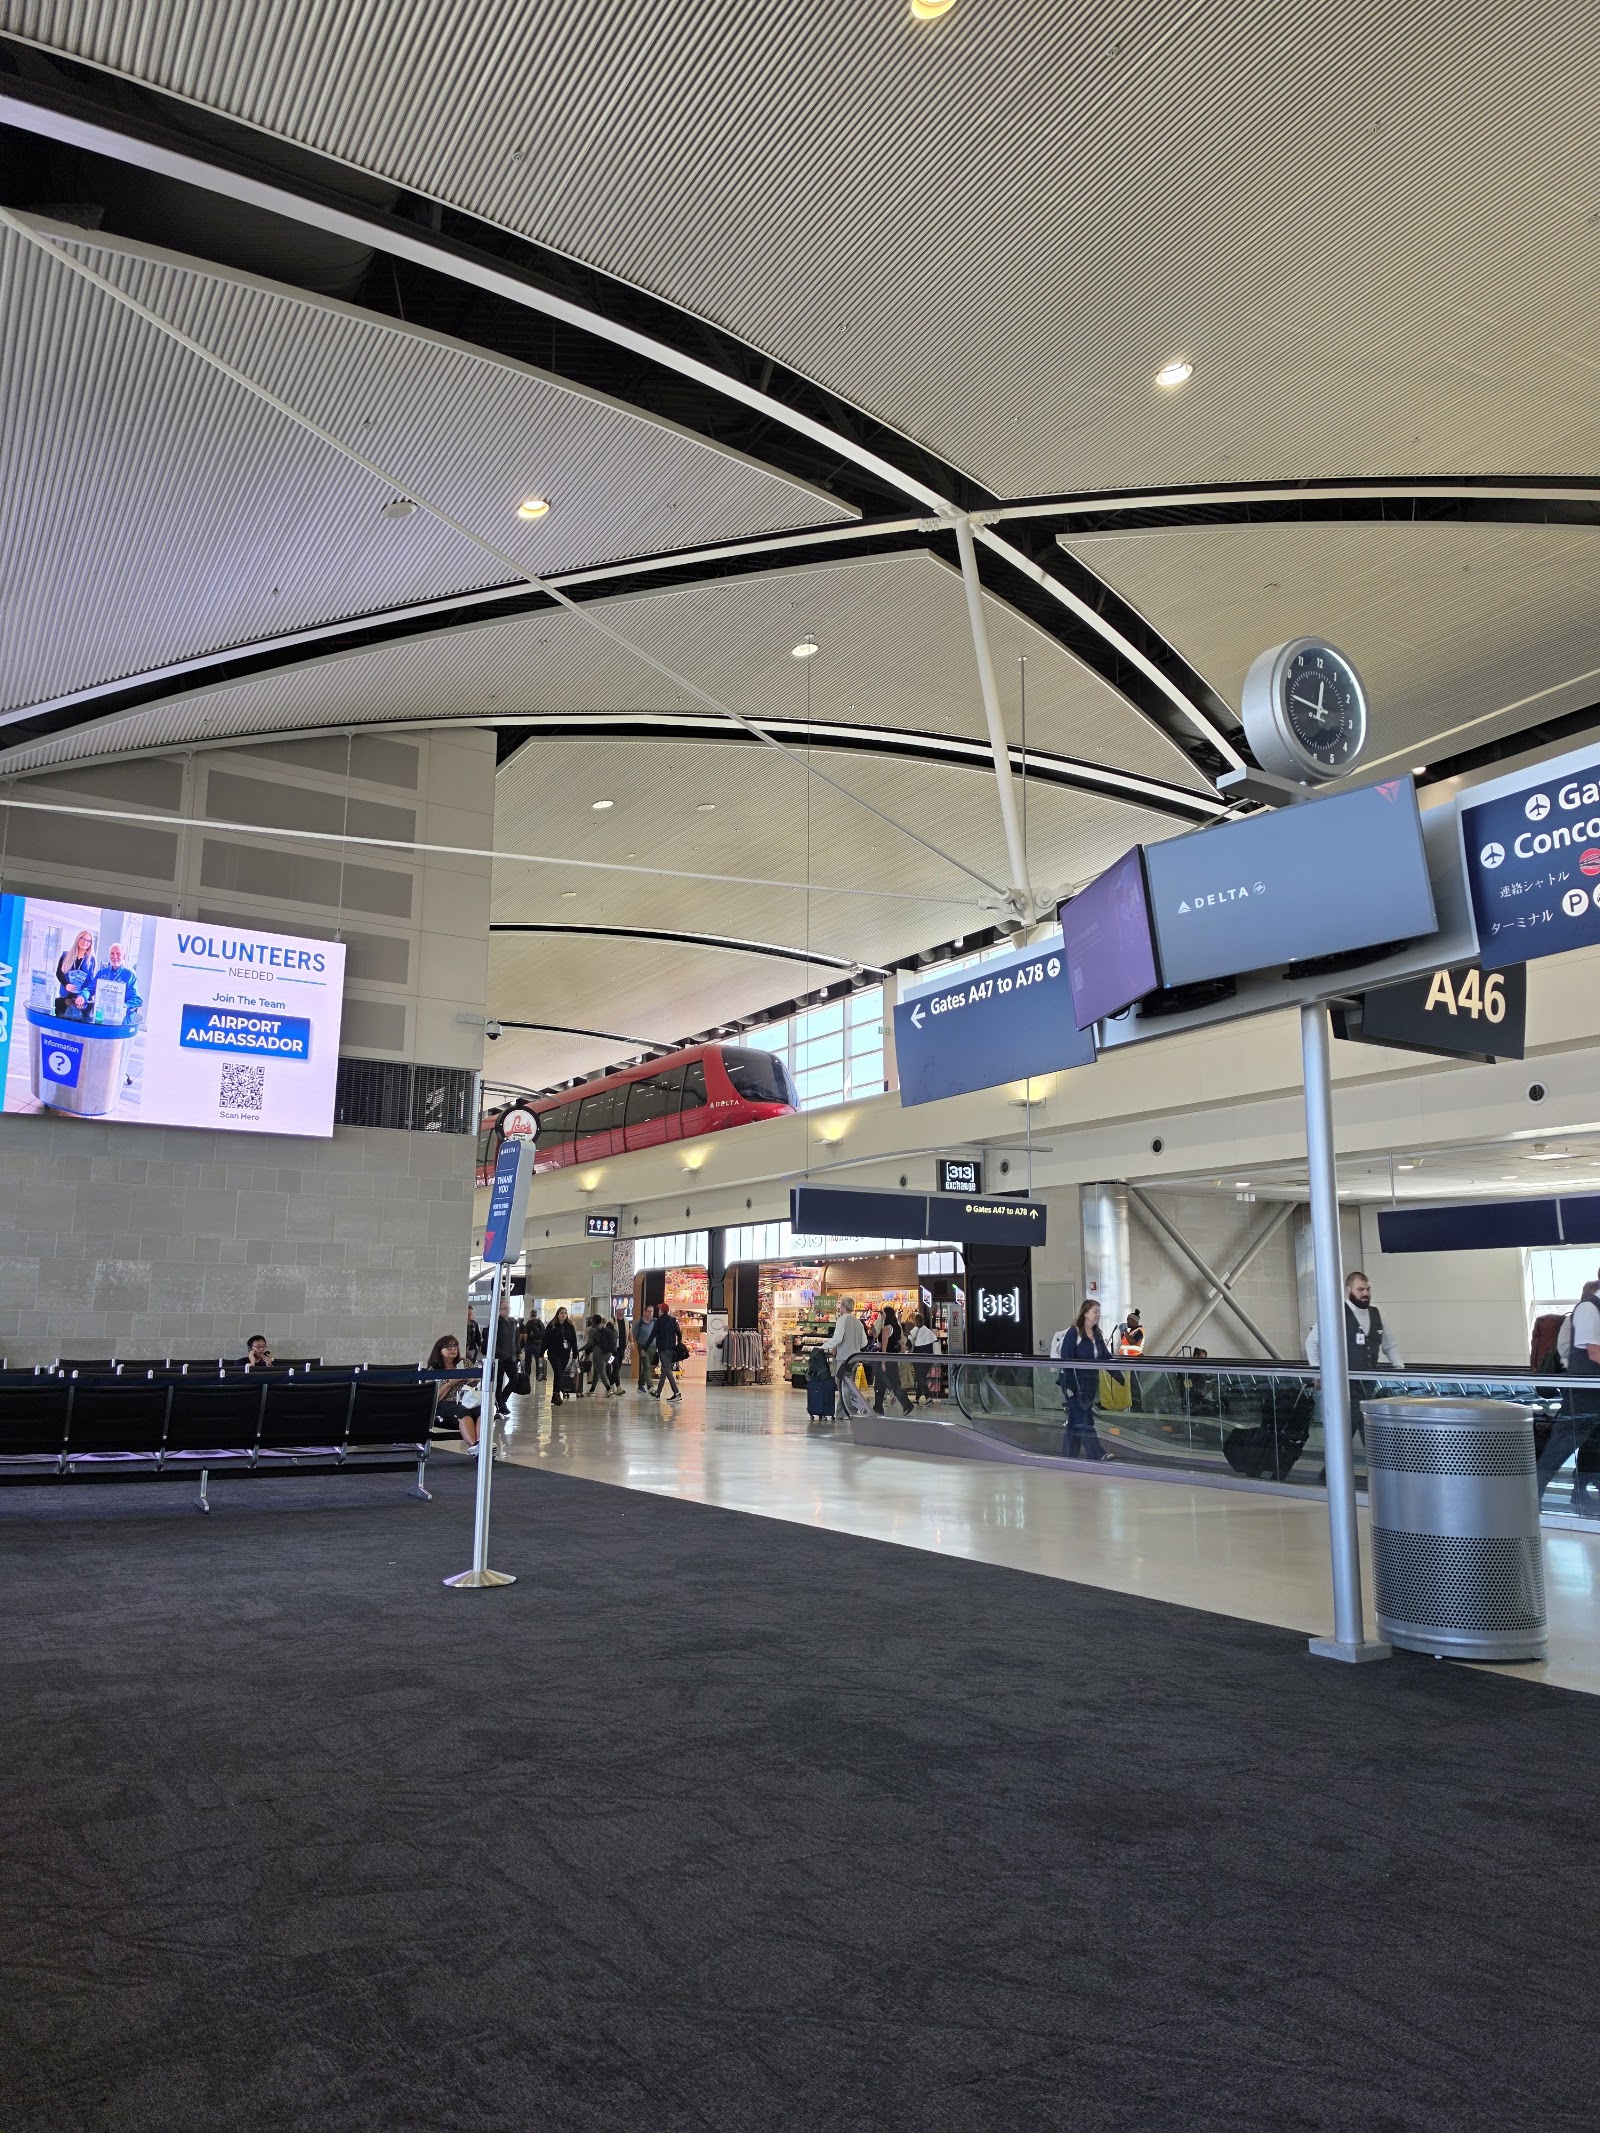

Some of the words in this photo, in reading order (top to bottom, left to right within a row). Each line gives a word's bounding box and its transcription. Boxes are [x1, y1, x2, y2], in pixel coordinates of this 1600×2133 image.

[1298, 656, 1304, 667] 11
[1316, 658, 1323, 668] 12
[1333, 672, 1337, 682] 1
[1346, 694, 1351, 704] 2
[1348, 720, 1353, 729] 3
[1342, 742, 1348, 752] 4
[1330, 753, 1335, 763] 5
[1558, 781, 1600, 810] Ga
[1514, 817, 1600, 859] Conco
[1499, 871, 1570, 898] 連絡シャトル
[1195, 886, 1249, 909] DELTA
[1569, 893, 1582, 912] P
[1491, 909, 1554, 936] ターミナル
[177, 933, 326, 972] VOLUNTEERS
[228, 967, 274, 982] NEEDED
[930, 992, 966, 1015] Gates
[968, 979, 994, 1004] A47
[997, 977, 1013, 994] to
[1016, 963, 1043, 988] A78
[1424, 968, 1506, 1024] A46
[212, 993, 235, 1004] Join
[237, 995, 257, 1006] The
[259, 997, 286, 1010] Team
[208, 1014, 282, 1034] AIRPORT
[43, 1038, 79, 1054] Information
[186, 1028, 303, 1053] AMBASSADOR
[715, 1099, 740, 1107] DELTA
[219, 1111, 239, 1120] Scan
[240, 1112, 260, 1121] Here
[497, 1175, 513, 1184] THANK
[945, 1181, 976, 1192] exchange
[499, 1185, 509, 1194] YOU
[973, 1205, 991, 1214] Gates
[992, 1206, 1005, 1214] A47
[1006, 1207, 1014, 1215] to
